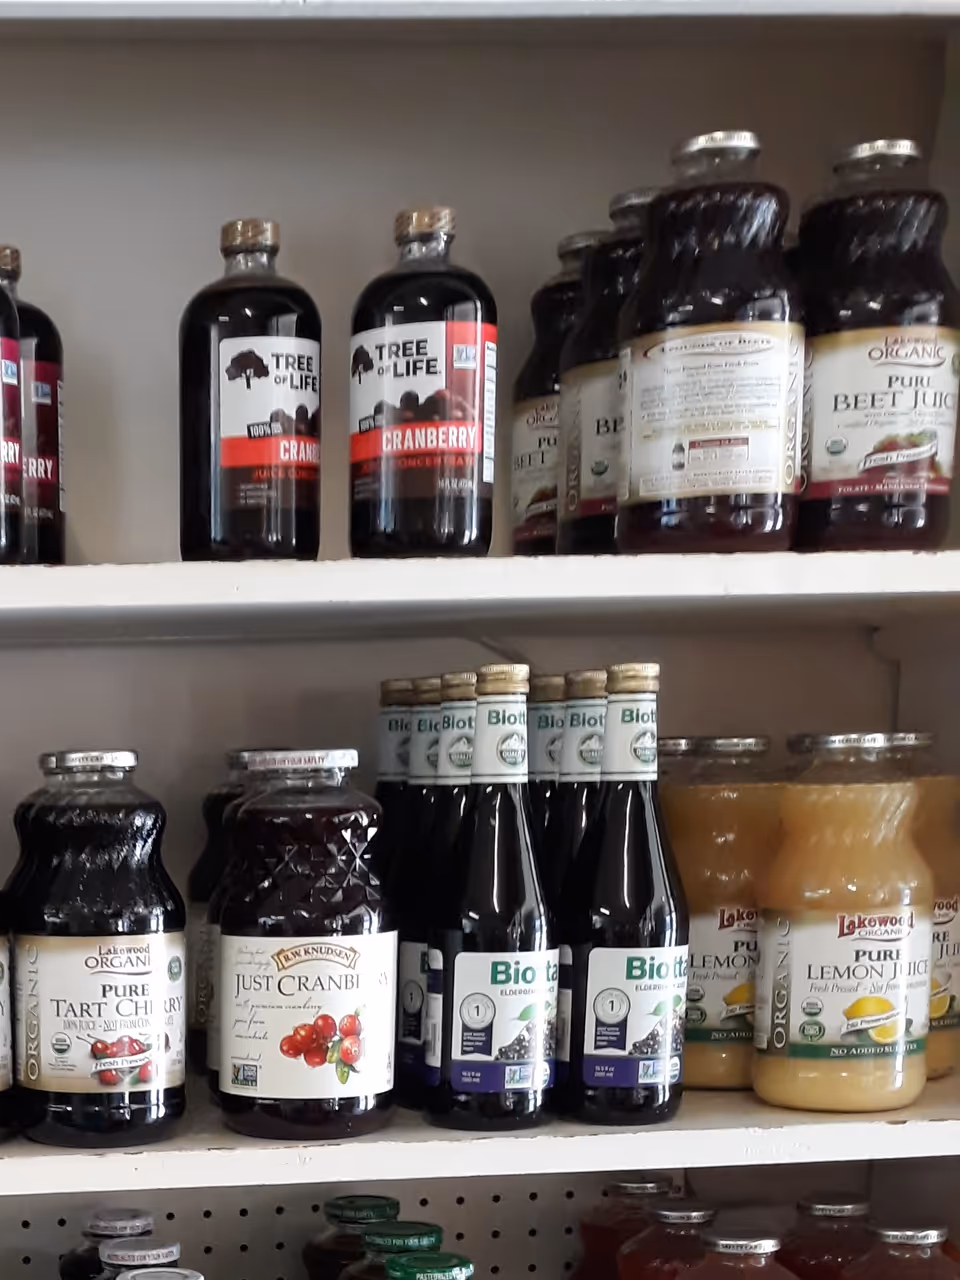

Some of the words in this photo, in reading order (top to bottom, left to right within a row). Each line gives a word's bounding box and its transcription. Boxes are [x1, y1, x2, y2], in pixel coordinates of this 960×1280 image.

[375, 338, 429, 360] TREE
[271, 352, 314, 373] TREE
[289, 373, 318, 393] LIFE
[833, 392, 904, 412] BEET
[248, 424, 272, 439] 100%
[382, 424, 477, 451] CRANBERRY
[837, 911, 915, 939] Lakewood
[98, 943, 151, 956] Lakewood
[303, 946, 352, 962] KNUDSEN
[689, 952, 761, 970] LEMON
[807, 963, 884, 981] LEMON
[100, 983, 150, 998] PURE
[234, 973, 274, 998] JUST
[771, 917, 791, 1049] ORGANIC
[49, 998, 108, 1018] TART
[474, 1004, 481, 1017] 1
[608, 999, 615, 1013] 1
[849, 1045, 884, 1056] ADDED
